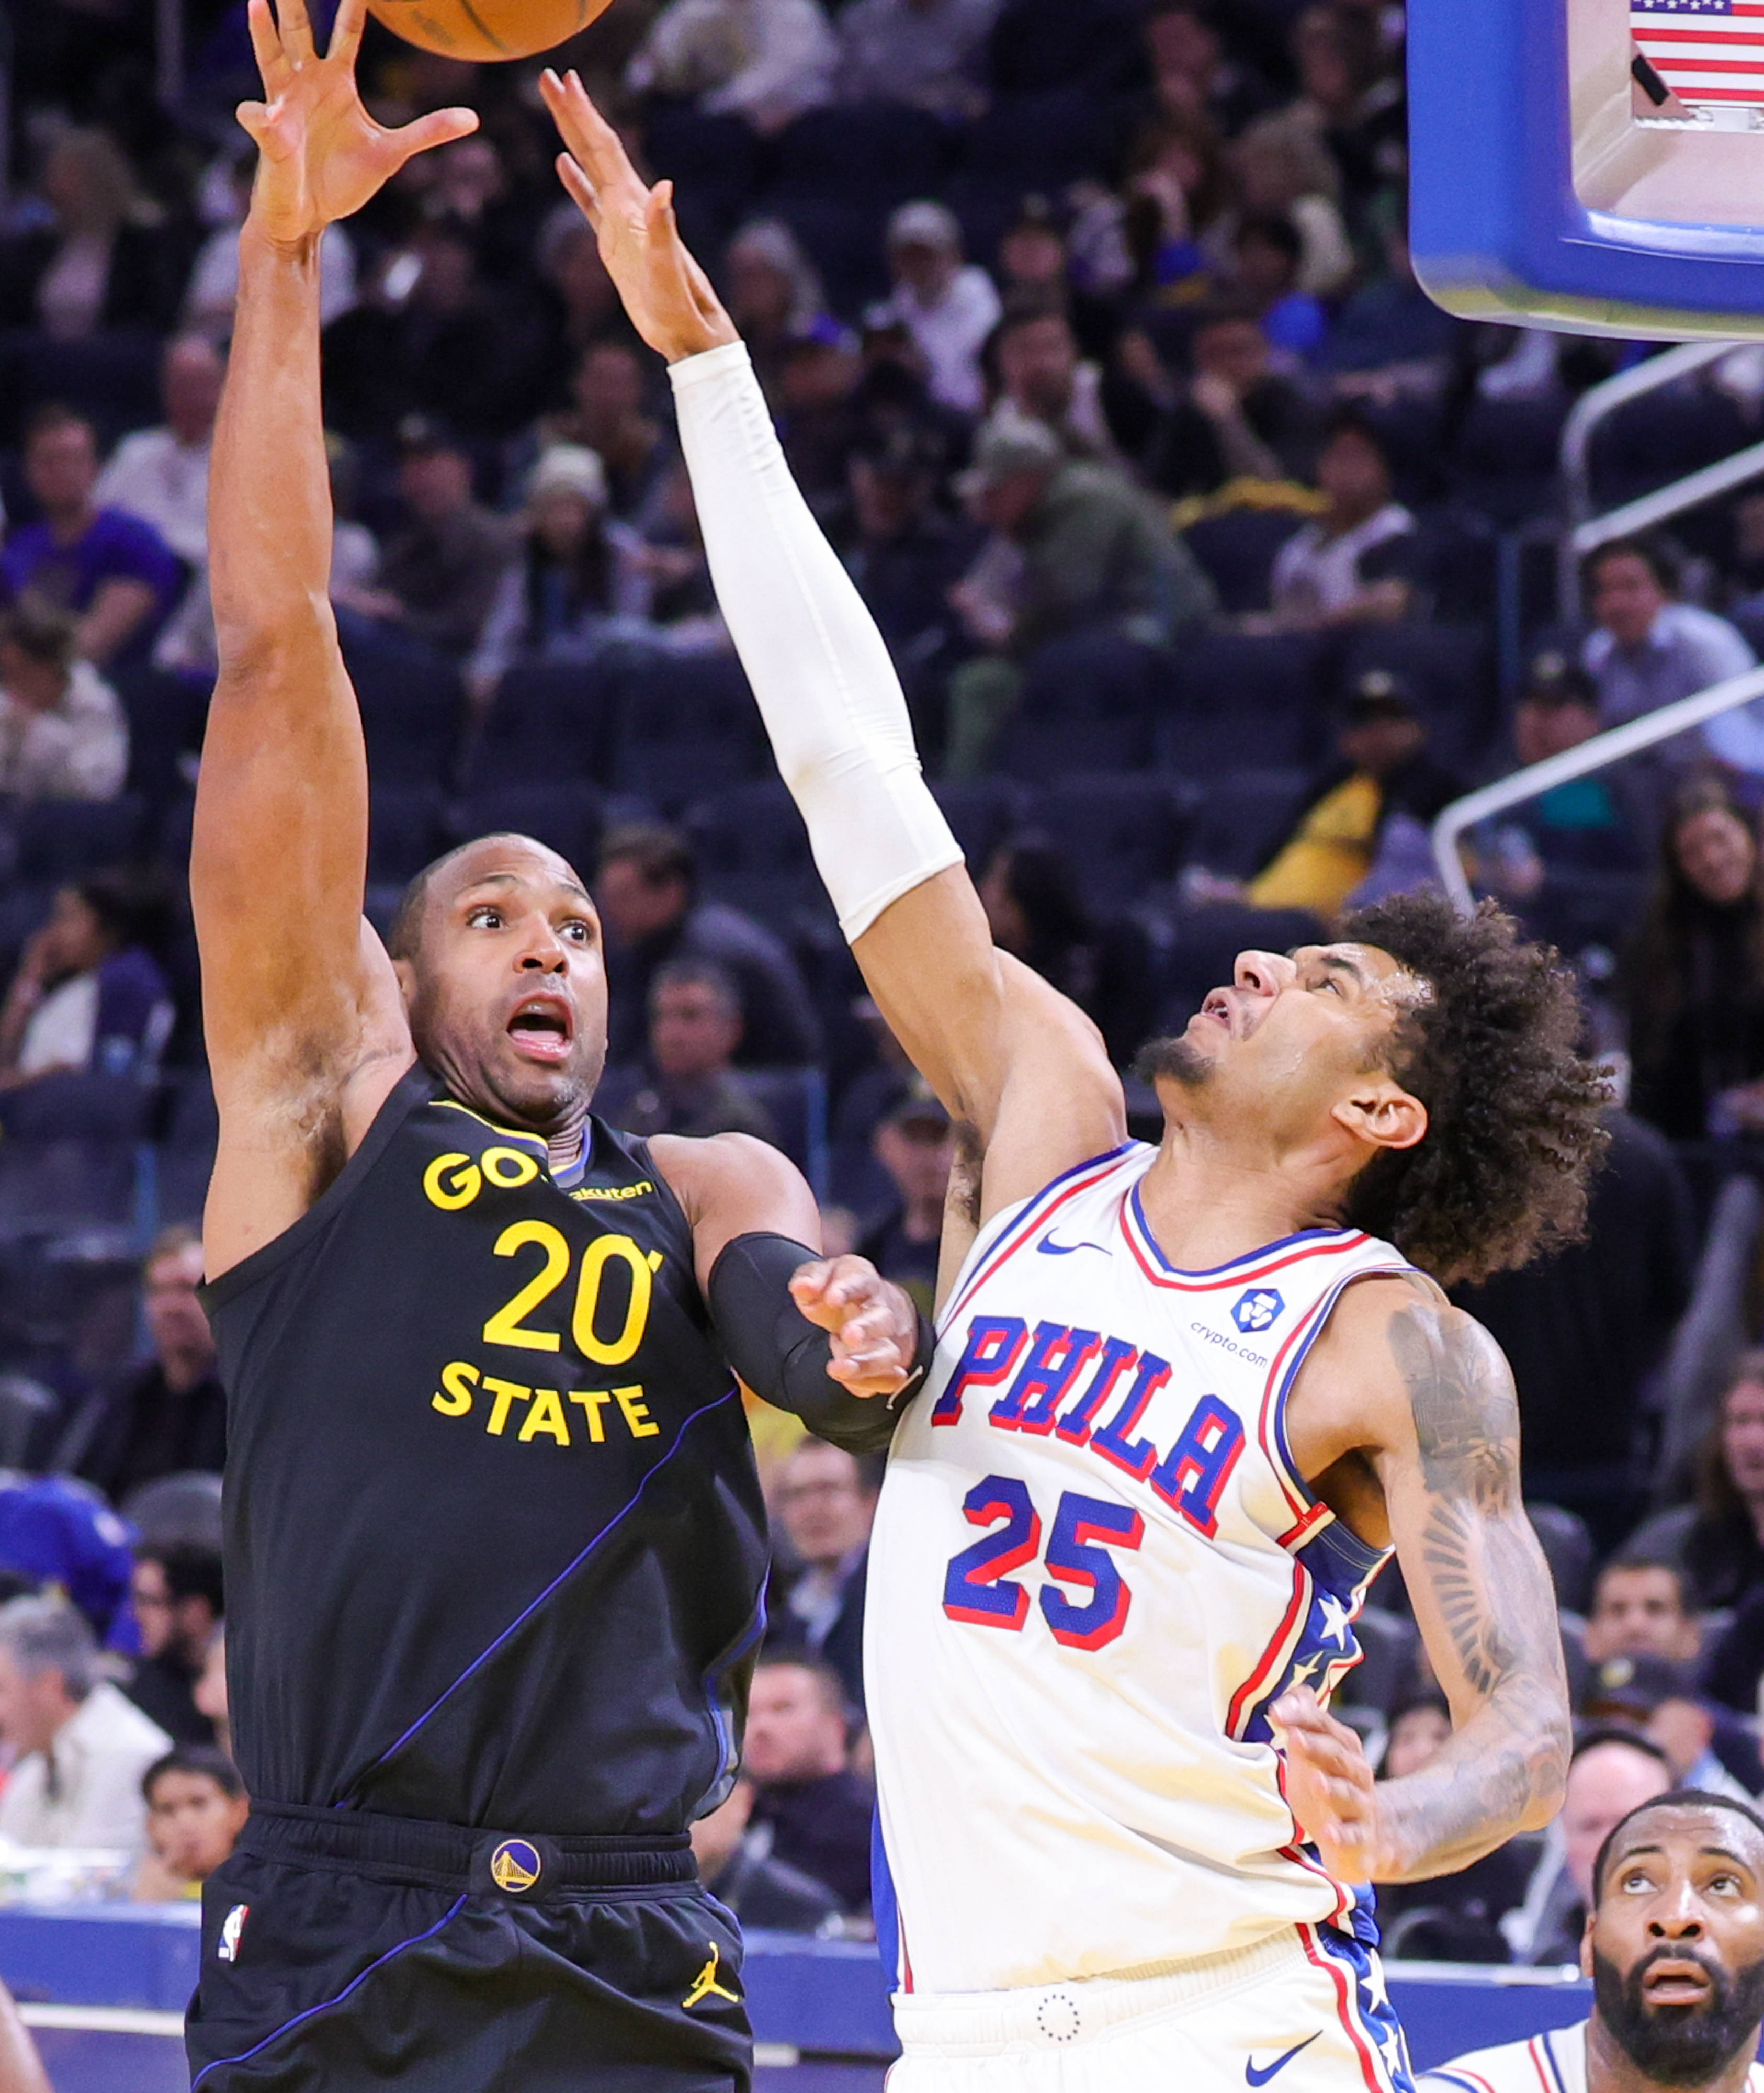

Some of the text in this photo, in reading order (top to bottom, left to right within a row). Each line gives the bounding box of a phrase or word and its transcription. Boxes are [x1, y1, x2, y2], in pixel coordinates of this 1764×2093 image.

[423, 1146, 549, 1210] GO
[568, 1181, 652, 1201] akuten
[483, 1219, 652, 1366] 20
[1190, 1322, 1268, 1368] crypto.com
[432, 1361, 661, 1446] STATE
[931, 1315, 1246, 1540] PHILA
[943, 1475, 1146, 1652] 25
